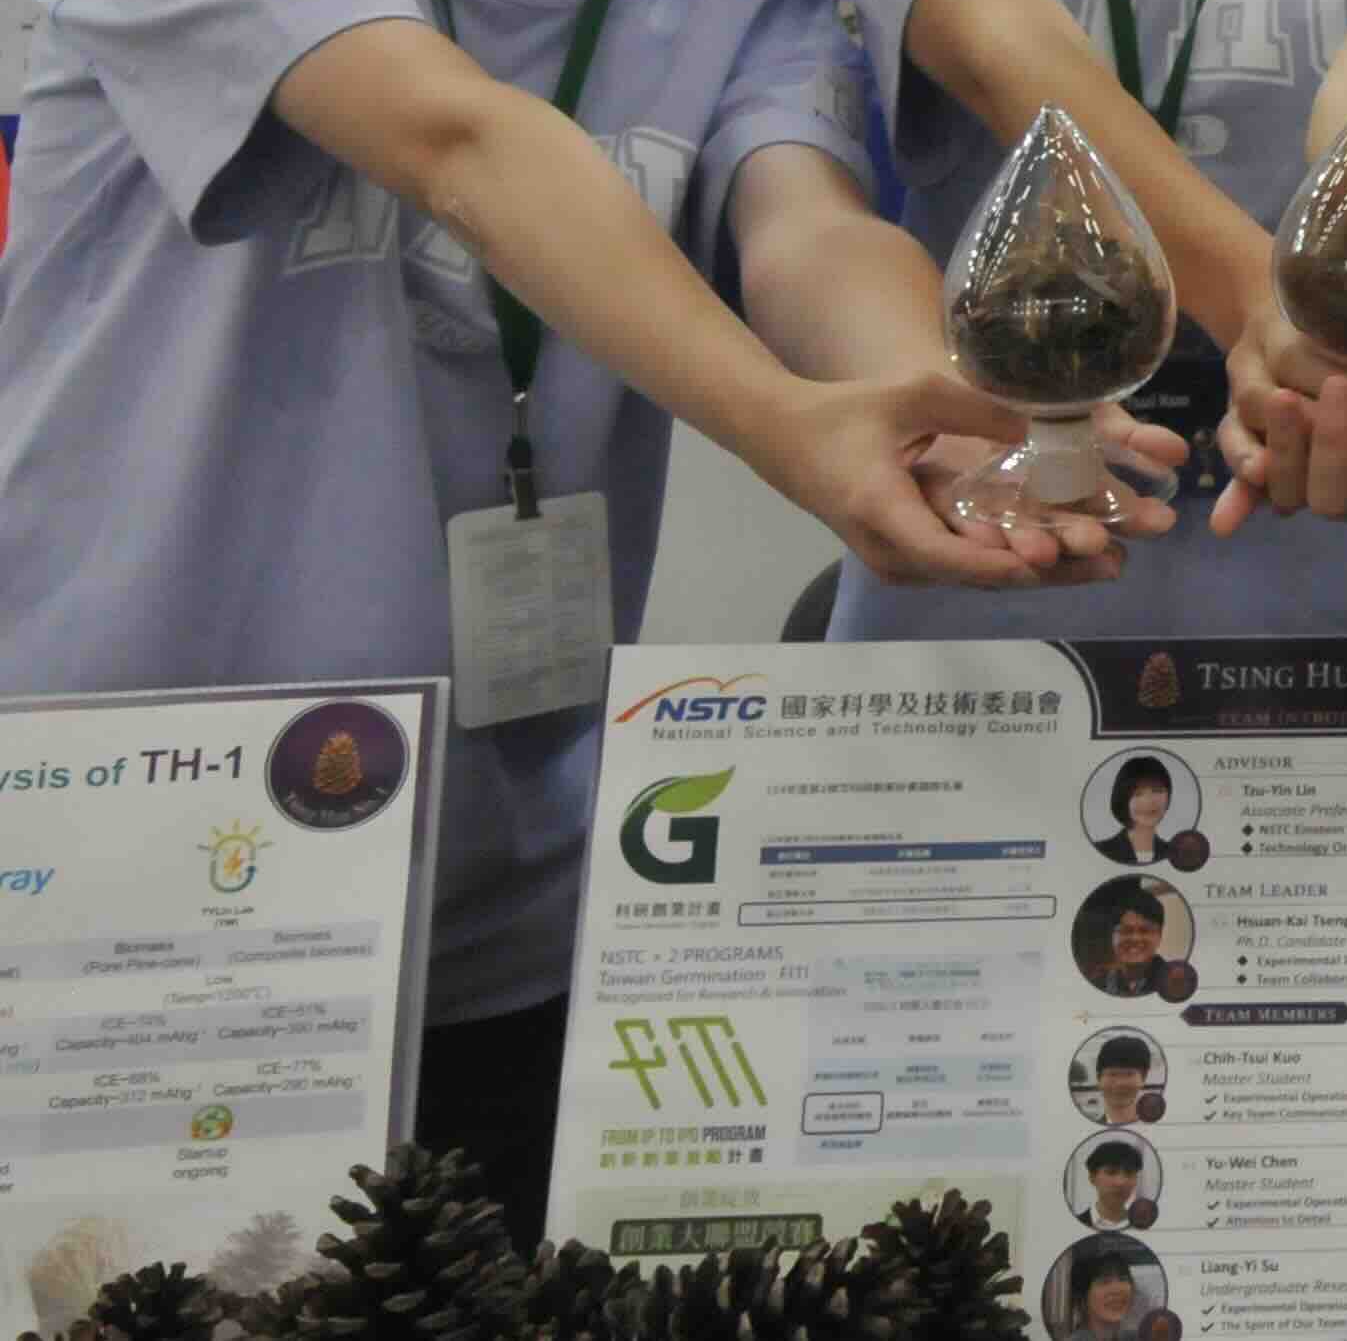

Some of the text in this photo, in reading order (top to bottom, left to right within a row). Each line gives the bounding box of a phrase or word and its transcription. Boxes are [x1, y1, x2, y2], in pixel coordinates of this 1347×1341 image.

[1197, 661, 1294, 690] TSING
[654, 695, 767, 723] NSTC
[780, 689, 1062, 722] 國家科學及技術委員會
[652, 719, 1058, 742] National Science and Technology Council
[86, 758, 128, 788] of
[139, 745, 245, 786] TH-1
[1213, 756, 1294, 771] ADVISOR
[1258, 841, 1329, 857] Technology
[1205, 883, 1329, 899] TEAM LEADER
[1236, 914, 1308, 928] Hsuan-Kai
[273, 929, 332, 944] Biomass
[114, 941, 175, 955] Biomass
[600, 945, 784, 966] NSTC PROGRAMS
[1256, 954, 1341, 968] Experimental
[599, 970, 656, 988] Taiwan
[660, 968, 767, 986] Germination
[1205, 1008, 1337, 1023] TEAM MEMBERS
[1202, 1050, 1302, 1066] Chih-Tsui Kuo
[1202, 1072, 1313, 1087] Master Student
[1223, 1092, 1299, 1106] Experimental
[702, 1124, 767, 1142] PROGRAM
[1261, 1155, 1299, 1169] Chen
[172, 1164, 229, 1181] ongoing
[1199, 1258, 1280, 1276] Liang-Yi Su
